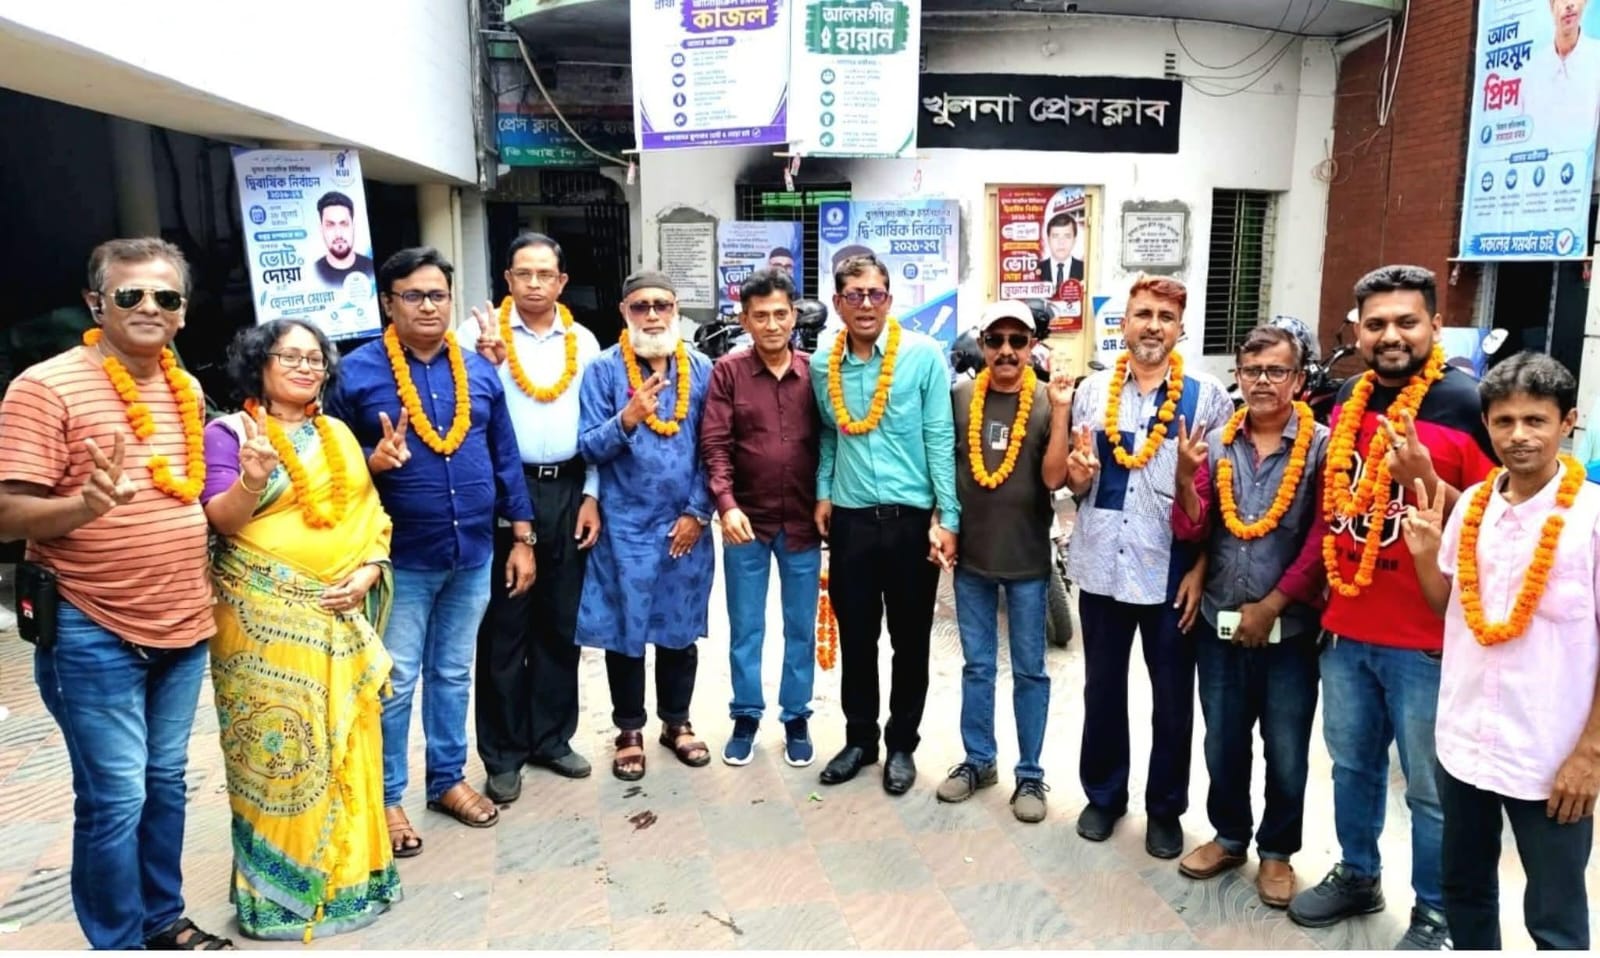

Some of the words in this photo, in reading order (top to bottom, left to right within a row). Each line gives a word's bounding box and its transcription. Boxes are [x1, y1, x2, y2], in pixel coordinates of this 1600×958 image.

[691, 5, 770, 28] কাজল
[822, 2, 896, 24] আলমগীর
[834, 27, 895, 51] হান্নান
[1488, 21, 1520, 45] আল
[1485, 40, 1534, 70] মাহমুদ
[1484, 73, 1522, 112] প্রিন্স
[923, 92, 1022, 128] খুলনা
[912, 219, 952, 236] নির্বাচন
[1480, 236, 1511, 254] সকলের
[1539, 231, 1556, 251] চাই
[259, 243, 297, 268] ভোট
[1003, 252, 1039, 272] ভোট
[262, 267, 301, 284] দোয়া
[270, 294, 305, 309] হেলাল
